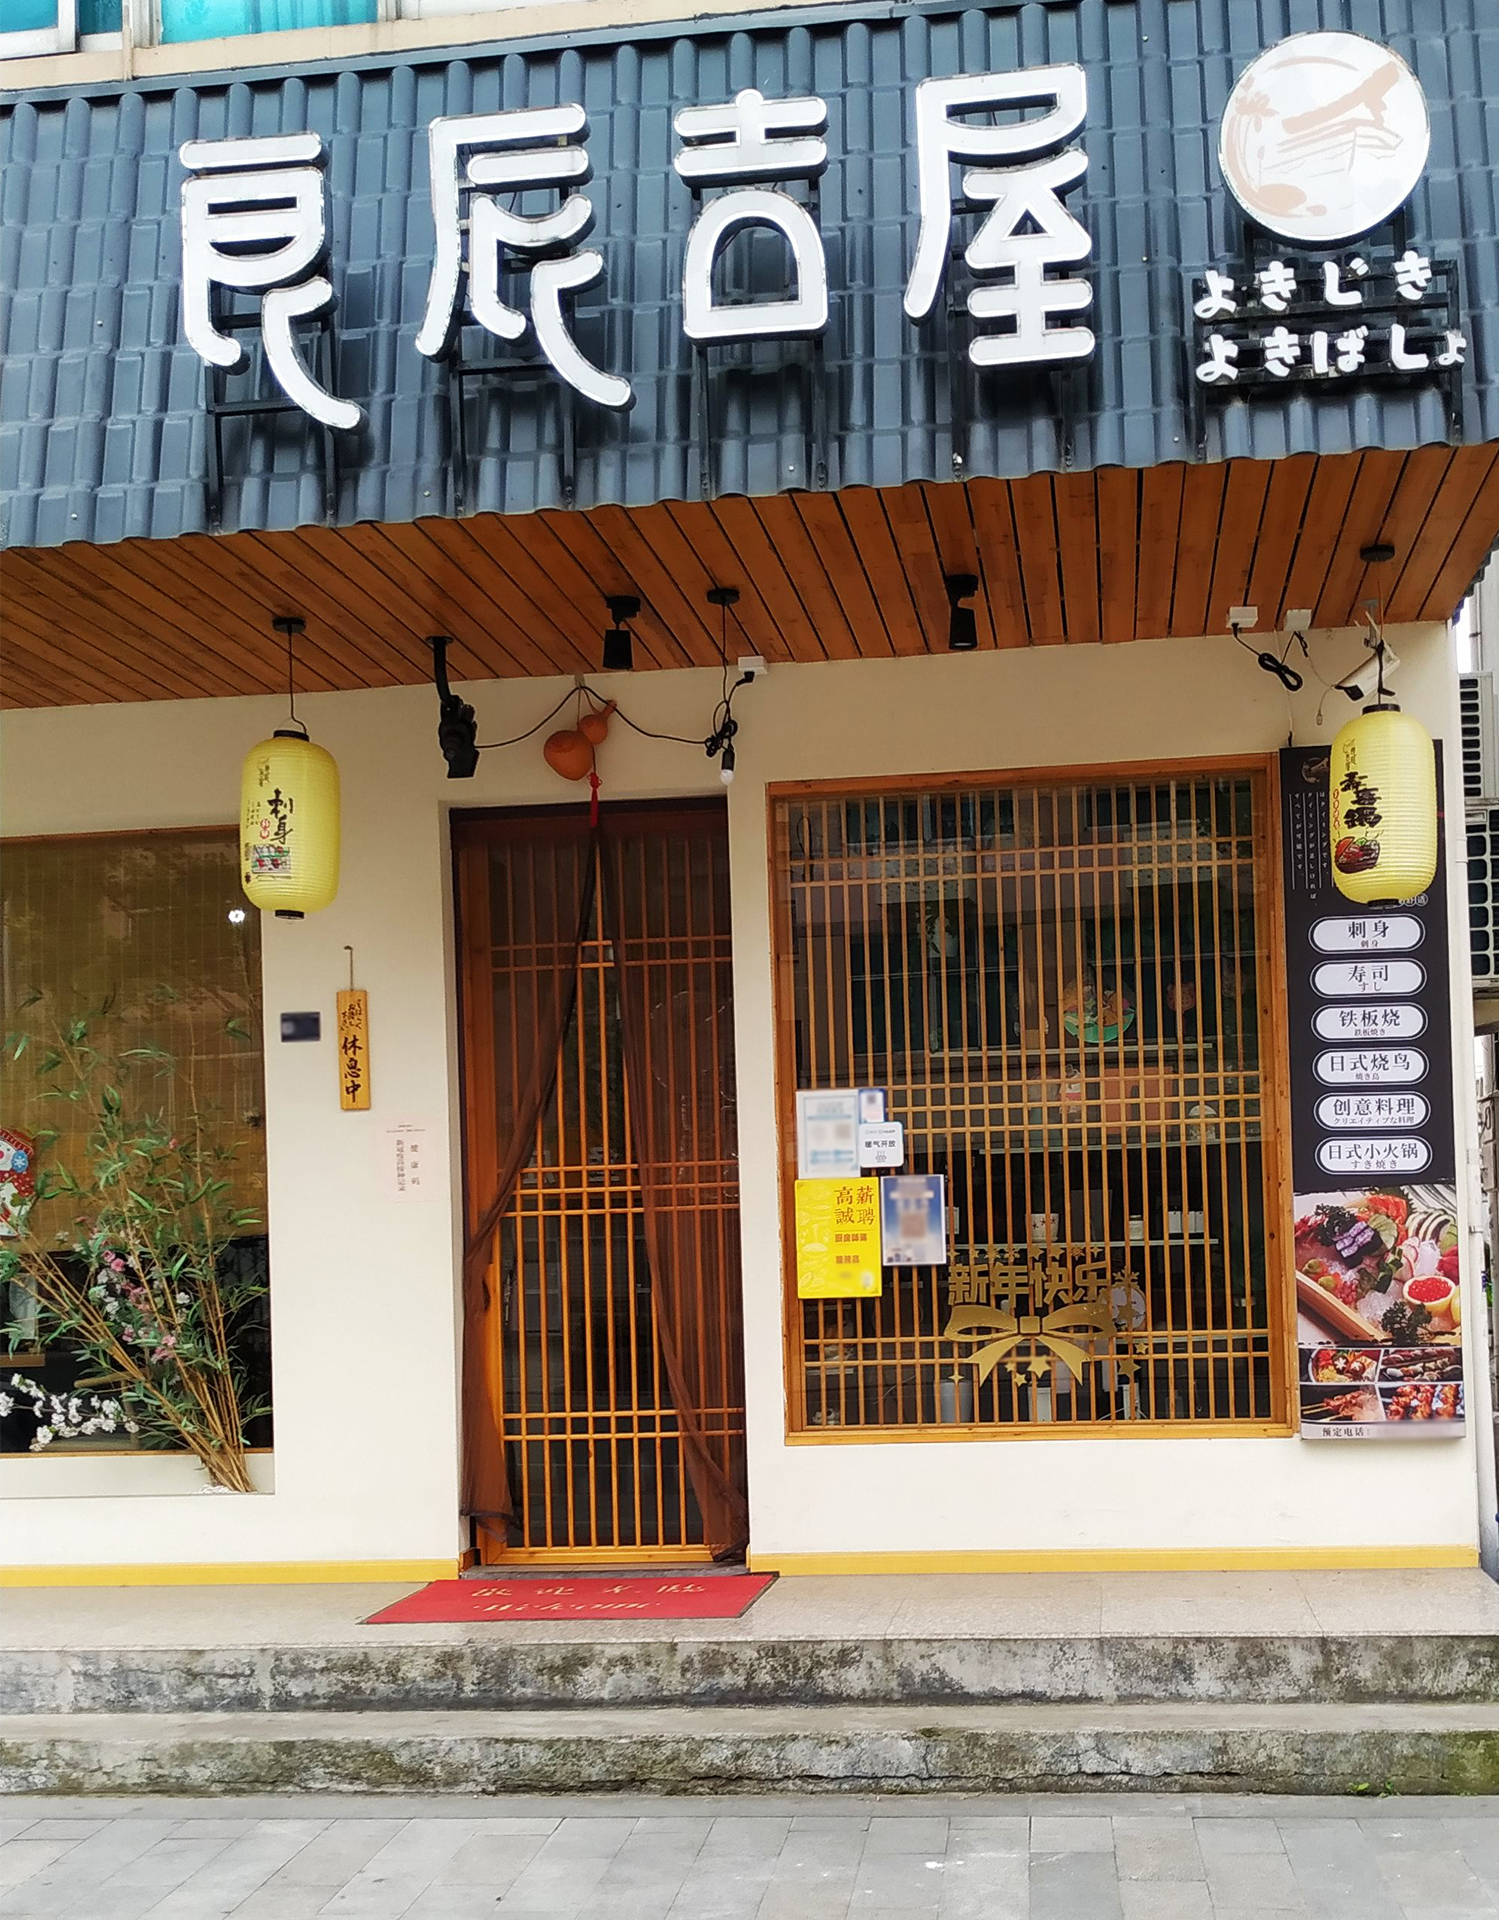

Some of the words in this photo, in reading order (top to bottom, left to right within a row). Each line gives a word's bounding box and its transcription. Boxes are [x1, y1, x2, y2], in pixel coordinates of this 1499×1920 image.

[179, 62, 1095, 429] 良辰吉屋
[1193, 249, 1432, 319] よきじき
[1196, 324, 1467, 383] よきばしょ
[266, 787, 294, 845] 刺身
[1347, 920, 1390, 939] 刺身
[1348, 964, 1389, 983] 寿司
[1358, 982, 1383, 992] すし
[1339, 1009, 1401, 1028] 铁板烧
[341, 1035, 363, 1103] 休息中
[1330, 1053, 1411, 1072] 日式烧鸟
[1333, 1098, 1415, 1116] 创意料理
[1333, 1115, 1415, 1125] クリエイティブな料理
[865, 1140, 896, 1148] 暖气开放
[1328, 1143, 1418, 1161] 日式小火锅
[1351, 1159, 1398, 1170] すき焼き
[834, 1184, 874, 1205] 高薪
[834, 1206, 875, 1225] 誠聘
[947, 1261, 1110, 1308] 新年快乐
